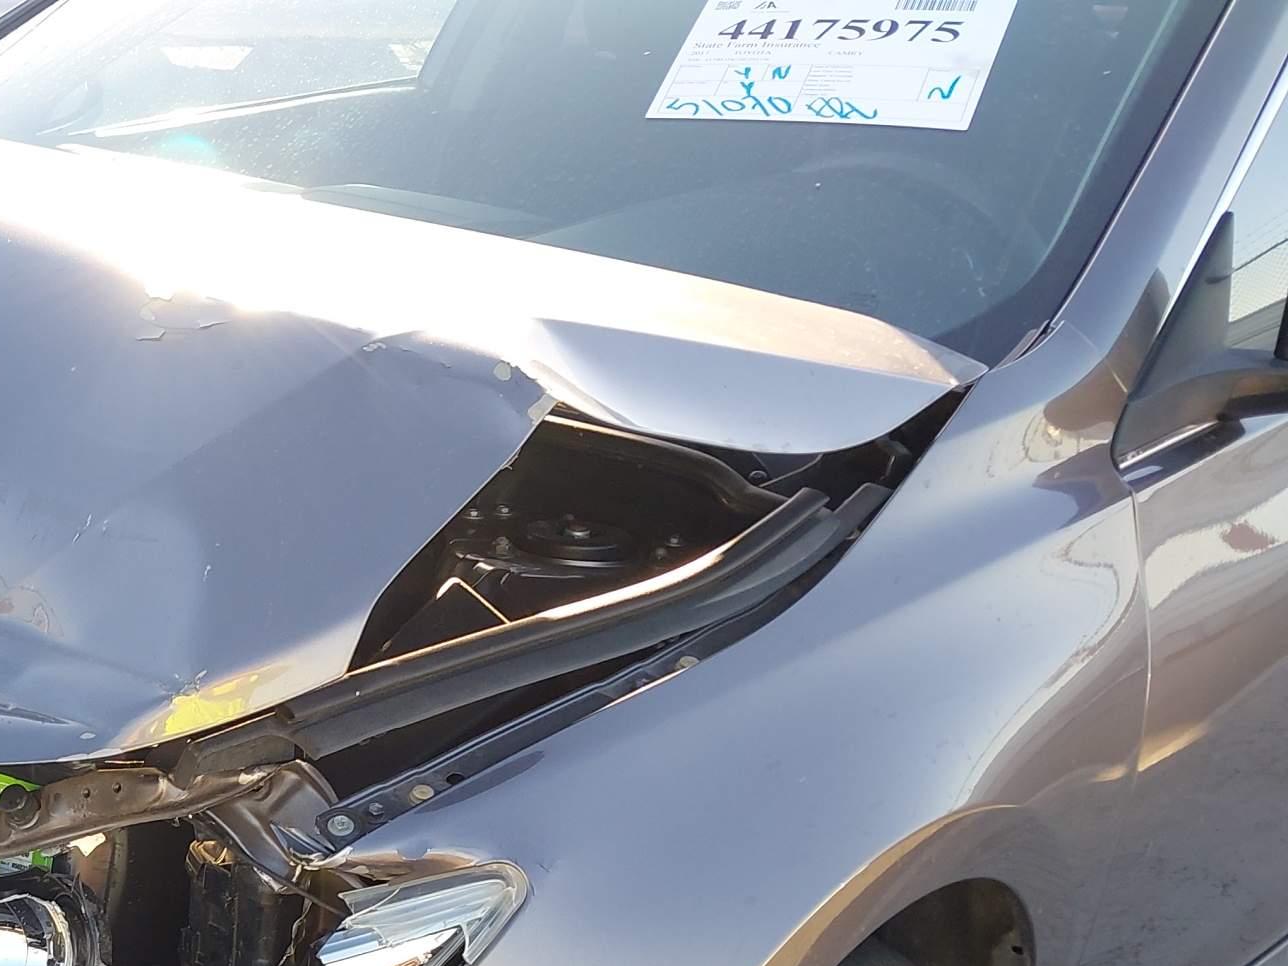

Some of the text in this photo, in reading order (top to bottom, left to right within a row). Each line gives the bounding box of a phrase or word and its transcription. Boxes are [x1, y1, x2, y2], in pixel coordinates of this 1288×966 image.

[718, 18, 965, 43] 44175975
[693, 41, 821, 49] State Farm Insurance
